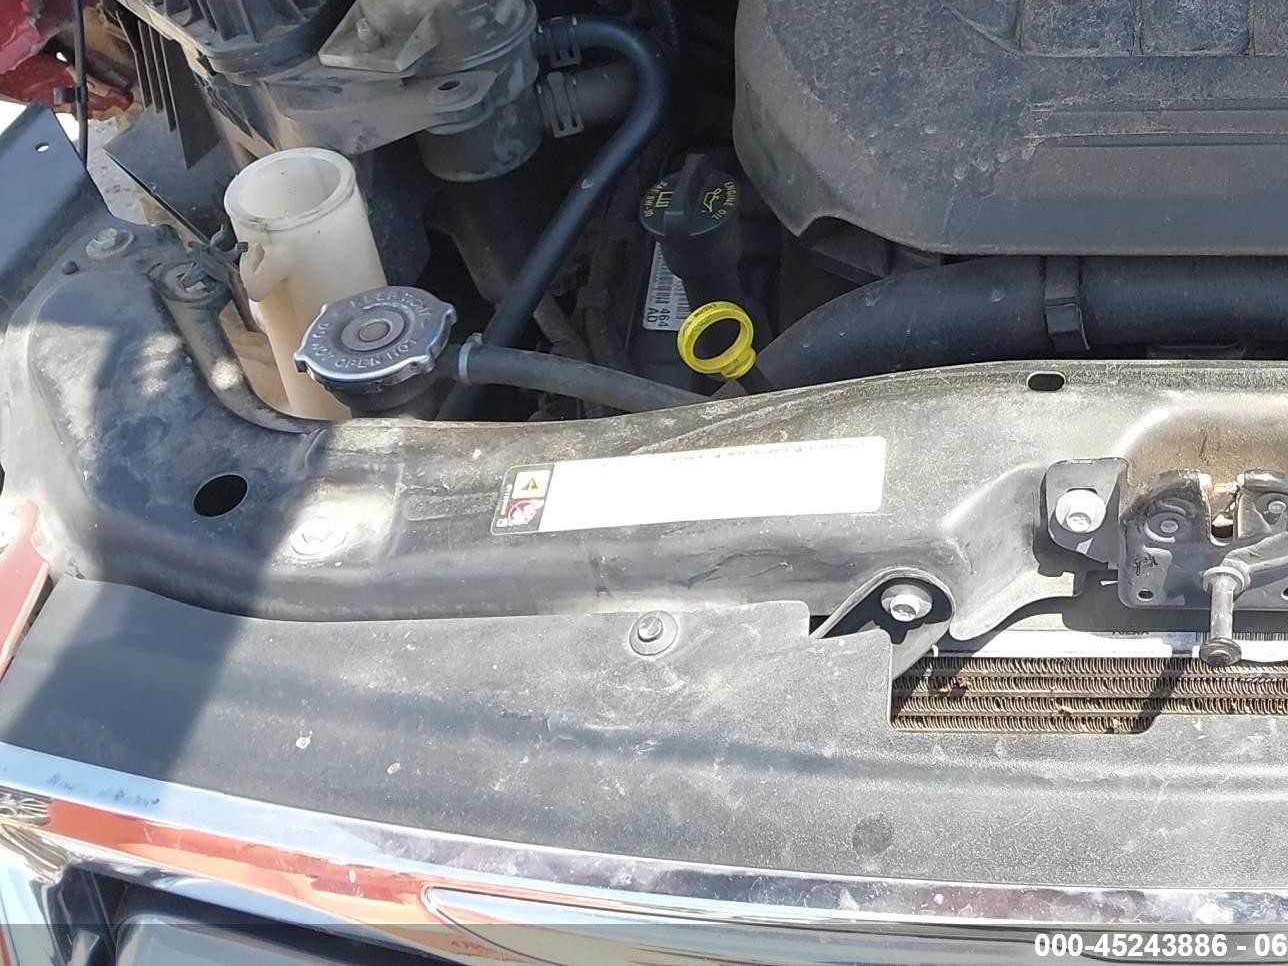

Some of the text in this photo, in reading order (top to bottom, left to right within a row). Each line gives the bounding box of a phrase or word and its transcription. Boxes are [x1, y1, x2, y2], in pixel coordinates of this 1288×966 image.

[711, 181, 738, 221] ENGINE OIL
[335, 357, 382, 369] OPEN
[387, 335, 418, 361] HOT
